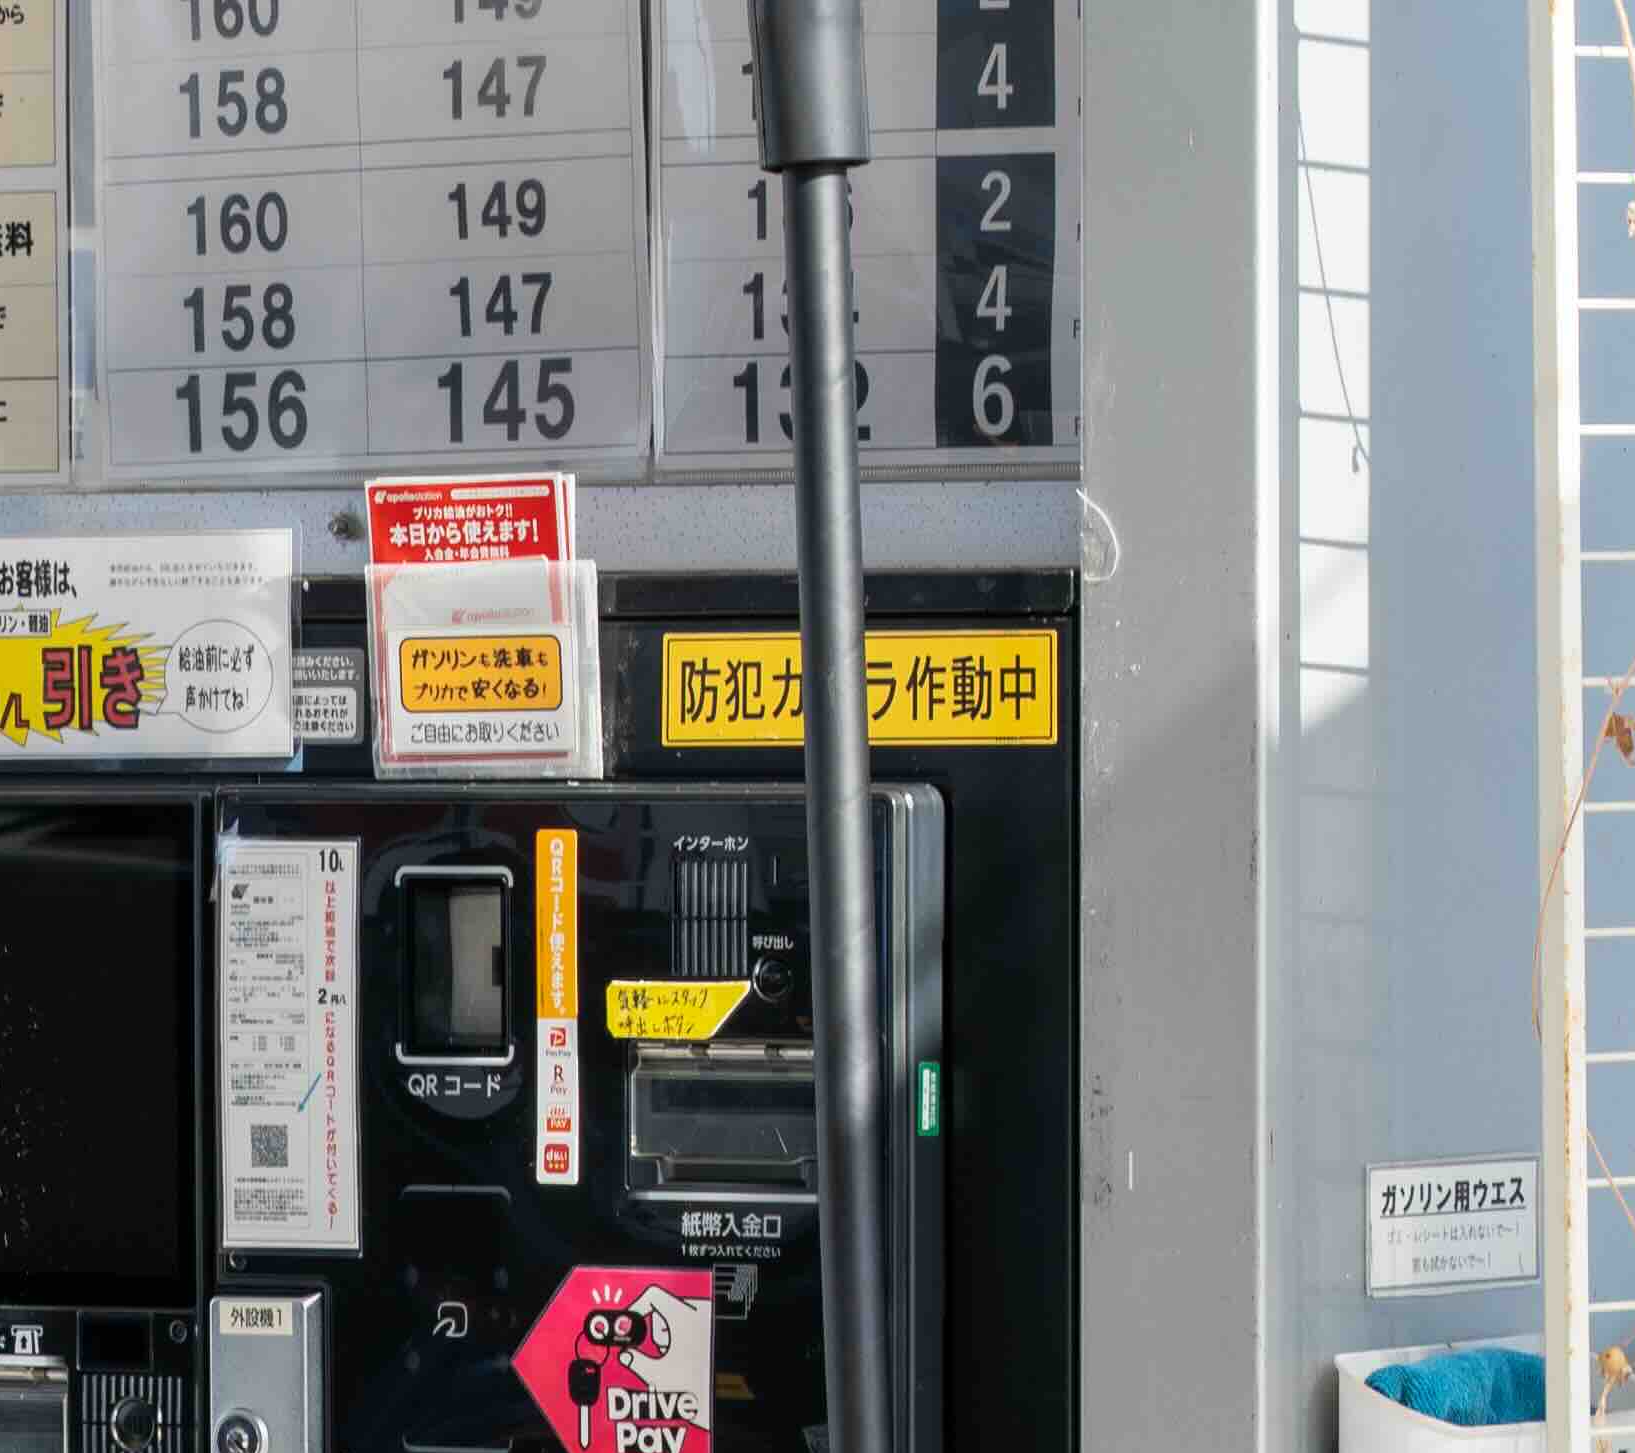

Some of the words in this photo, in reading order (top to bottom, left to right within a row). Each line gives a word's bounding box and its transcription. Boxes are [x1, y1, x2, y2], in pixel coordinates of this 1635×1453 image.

[178, 66, 290, 139] 158
[442, 55, 549, 122] 147
[976, 42, 1013, 110] 4
[185, 191, 290, 256] 160
[447, 178, 548, 241] 149
[979, 171, 1012, 232] 2
[182, 282, 297, 354] 158
[448, 271, 554, 339] 147
[975, 264, 1013, 332] 4
[175, 368, 309, 456] 156
[436, 357, 576, 443] 145
[972, 354, 1015, 437] 6
[389, 517, 540, 547] 本日から使えます!
[177, 643, 256, 674] 給油前に必ず
[412, 648, 549, 672] ガソリンも洗車も
[680, 653, 1038, 725] 防犯カラ作動中
[410, 720, 561, 745] ご自由にお取りください
[672, 835, 749, 851] インターホン
[752, 935, 795, 951] 呼び出し
[680, 1212, 782, 1239] 紙幣入金口
[1381, 1175, 1526, 1217] ガソリン用ウエス
[606, 1384, 700, 1423] Drive
